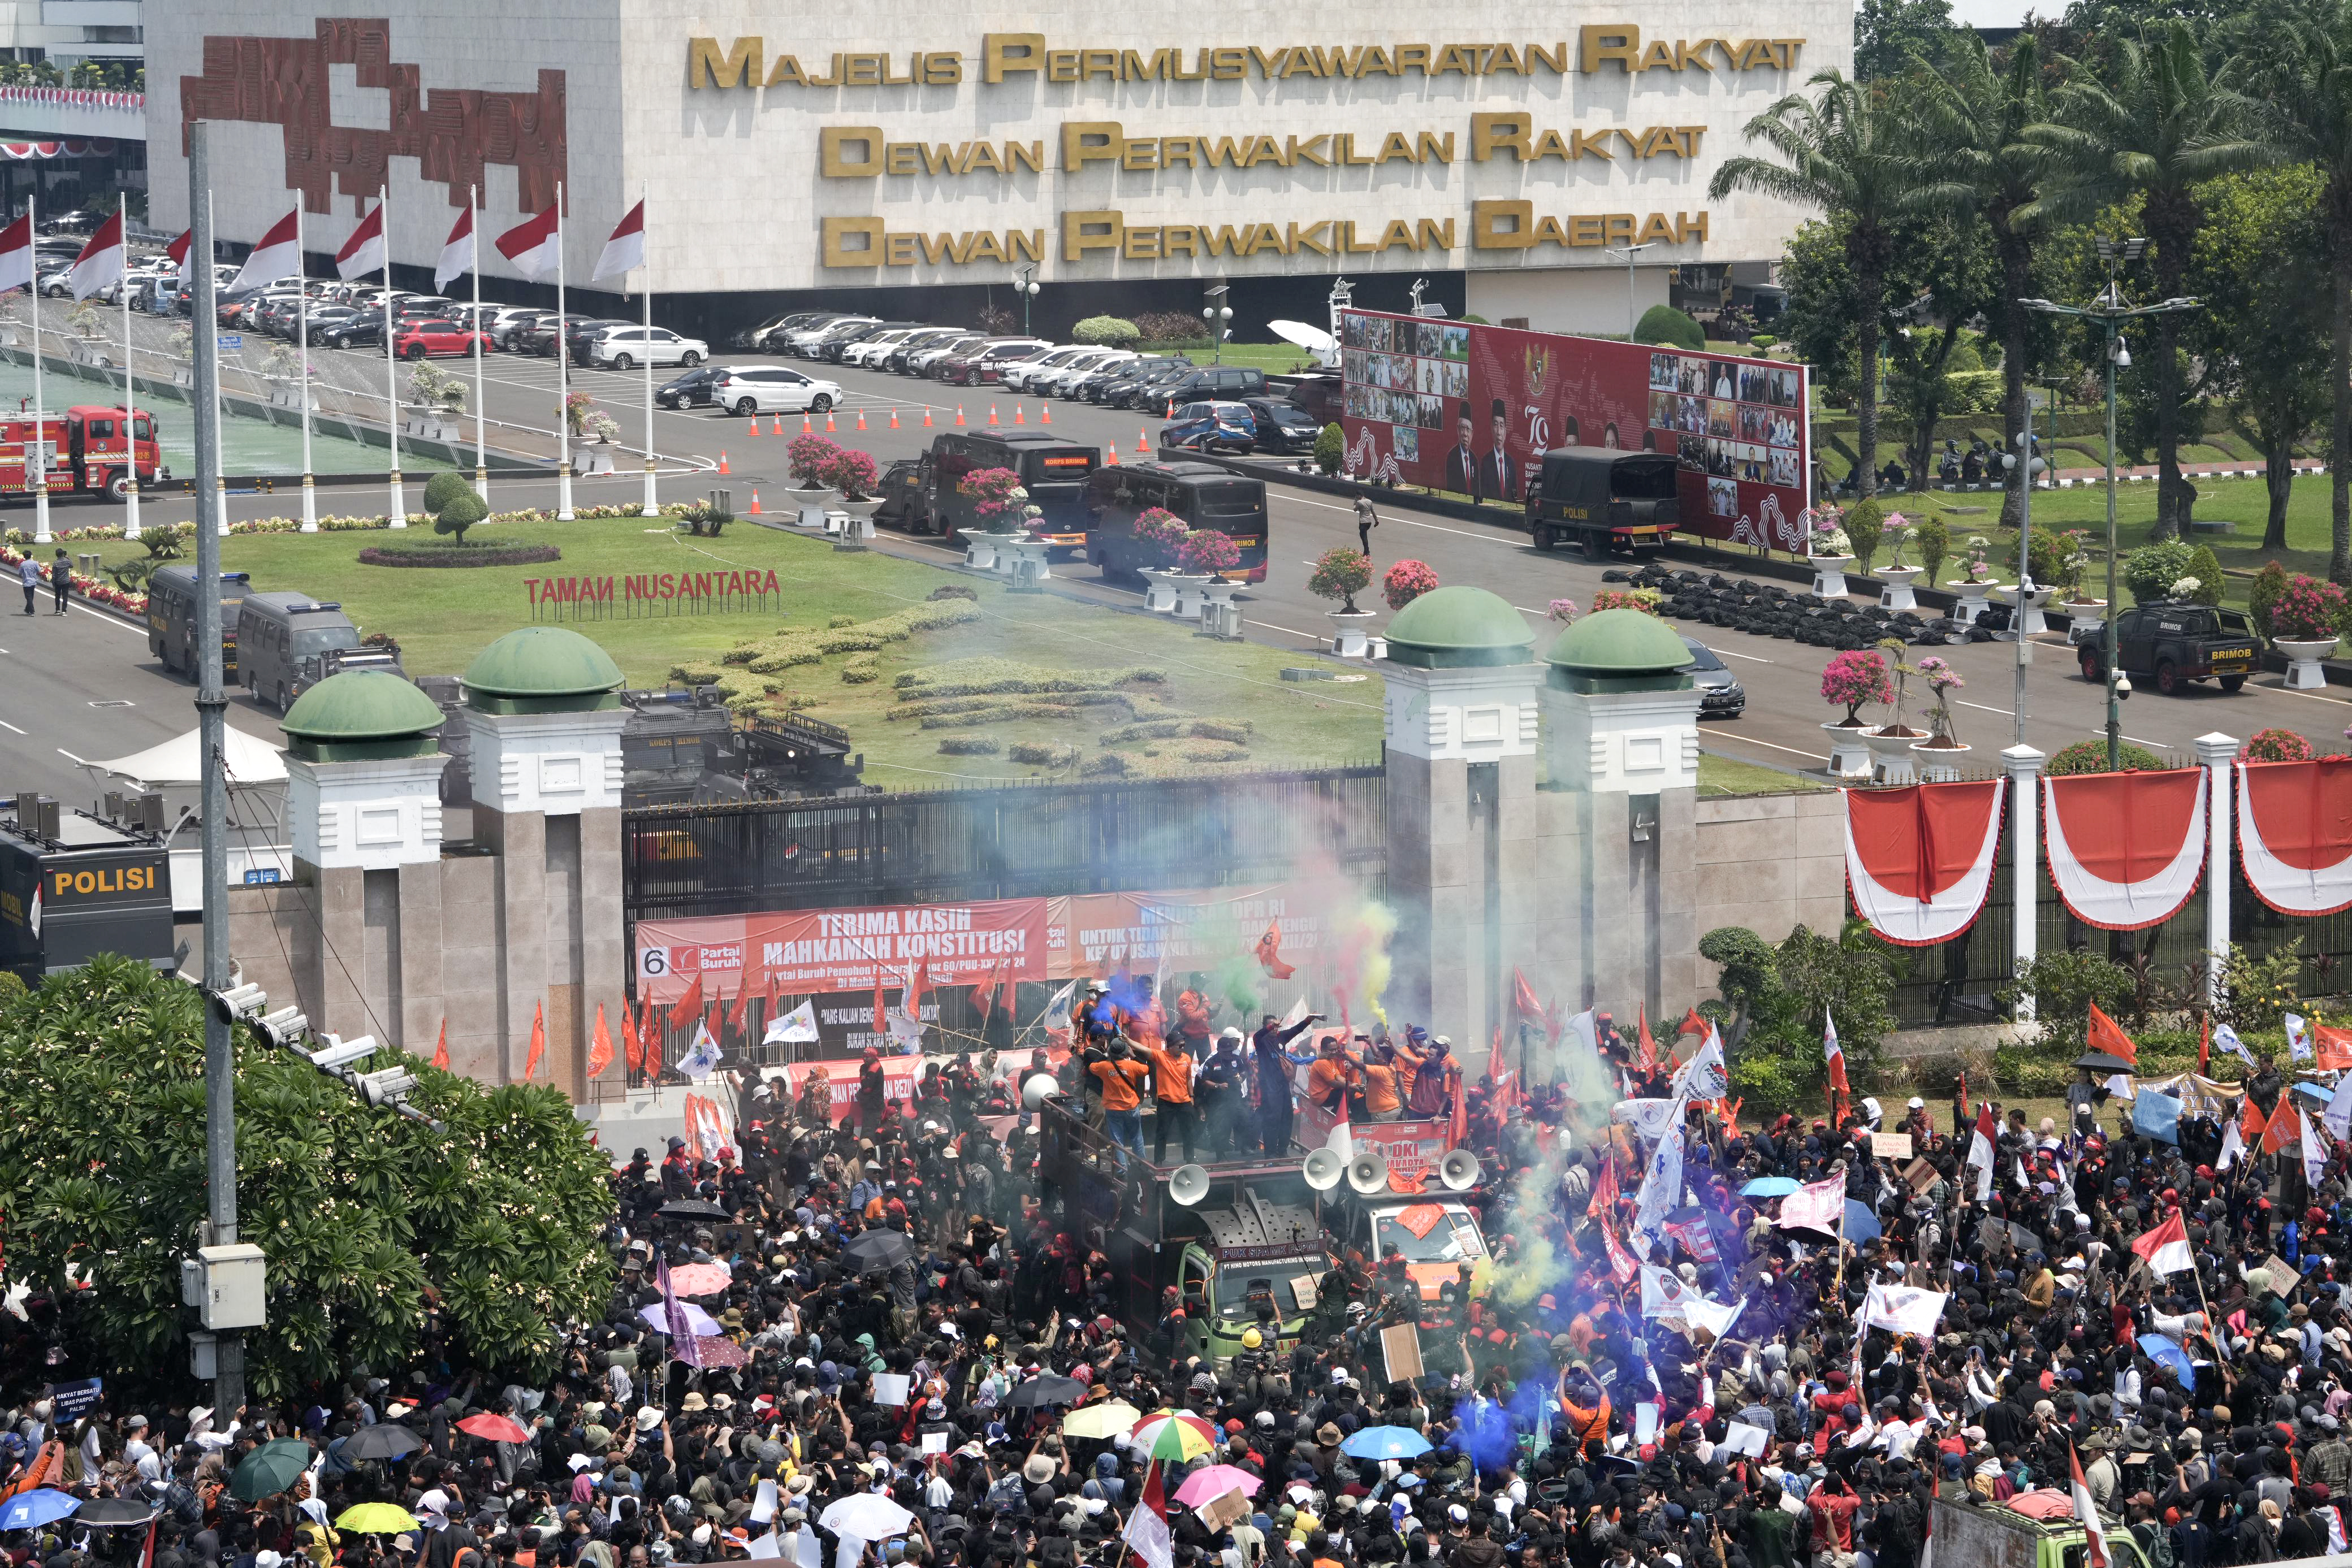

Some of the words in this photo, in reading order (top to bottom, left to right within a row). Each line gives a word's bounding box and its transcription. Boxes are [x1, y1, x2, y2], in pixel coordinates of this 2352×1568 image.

[689, 36, 962, 89] MAJELIS
[983, 33, 1567, 84] PERMUSYAWARATAN
[1580, 23, 1806, 73] RAKYAT
[820, 126, 1044, 177] DEWAN
[1061, 121, 1455, 174] PERWAKILAN
[1472, 111, 1707, 162] RAKYAT
[821, 216, 1045, 267] DEWAN
[1061, 210, 1455, 262] PERWAKILAN
[1472, 199, 1709, 249] DAERAH
[1563, 506, 1588, 520] POLISI
[524, 575, 613, 604] TAMAN
[625, 570, 780, 599] NUSANTARA
[151, 616, 167, 633] POLISI
[2160, 621, 2182, 632] BRIMOB
[2211, 648, 2252, 661] BRIMOB
[55, 867, 154, 895] POLISI
[818, 911, 900, 937] TERIMA
[905, 908, 971, 933] KASIH
[1079, 928, 1126, 946] UNTUK
[1128, 925, 1169, 942] TIDAK
[700, 946, 740, 959] Partai
[763, 935, 891, 966] MAHKAMAH
[897, 929, 1025, 958] KONSTITUSI
[645, 950, 664, 974] 6
[701, 956, 740, 969] Buruh
[798, 967, 826, 980] Buruh
[827, 965, 870, 977] Pemohon
[837, 978, 847, 988] Di
[838, 1007, 858, 1024] KALIAN
[859, 1007, 874, 1024] DENG
[847, 1032, 866, 1049] BUKAN
[2317, 1038, 2327, 1054] 6
[1392, 1143, 1419, 1158] DKI
[1386, 1158, 1424, 1174] JAKARTA
[1222, 1247, 1247, 1259] PUK
[1288, 1242, 1319, 1254] FSPMI
[1261, 1257, 1296, 1266] MANUFACTURING
[1297, 1255, 1321, 1264] INDONESIA
[2266, 1263, 2290, 1286] PANIK
[57, 1391, 76, 1400] RAKYAT
[77, 1387, 100, 1396] BERSATU
[61, 1398, 76, 1407] LIBAS
[76, 1396, 95, 1405] PARPOL
